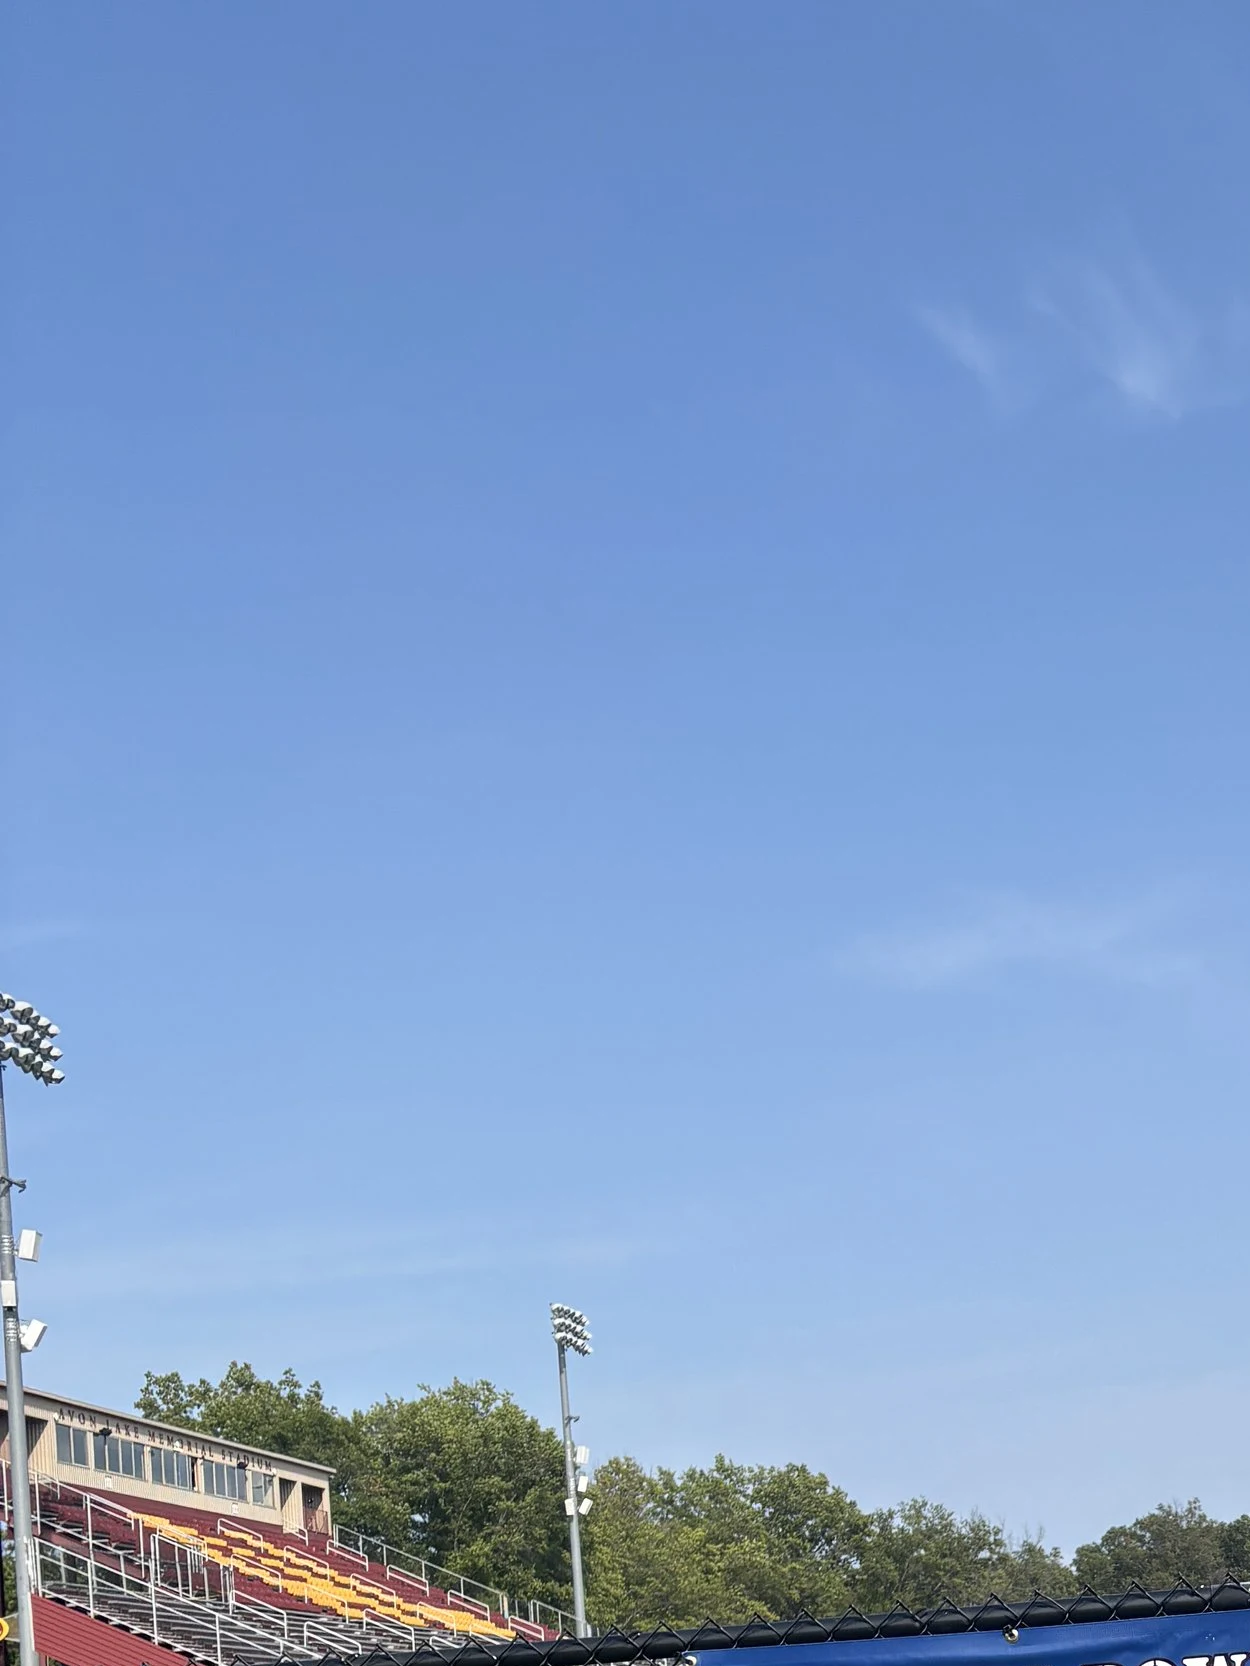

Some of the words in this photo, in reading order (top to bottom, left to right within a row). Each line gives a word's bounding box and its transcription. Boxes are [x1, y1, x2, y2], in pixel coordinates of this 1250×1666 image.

[59, 1407, 97, 1428] AVON
[105, 1419, 140, 1439] LAKE
[147, 1430, 214, 1458] MEMORIAL
[221, 1448, 273, 1472] STADIUM
